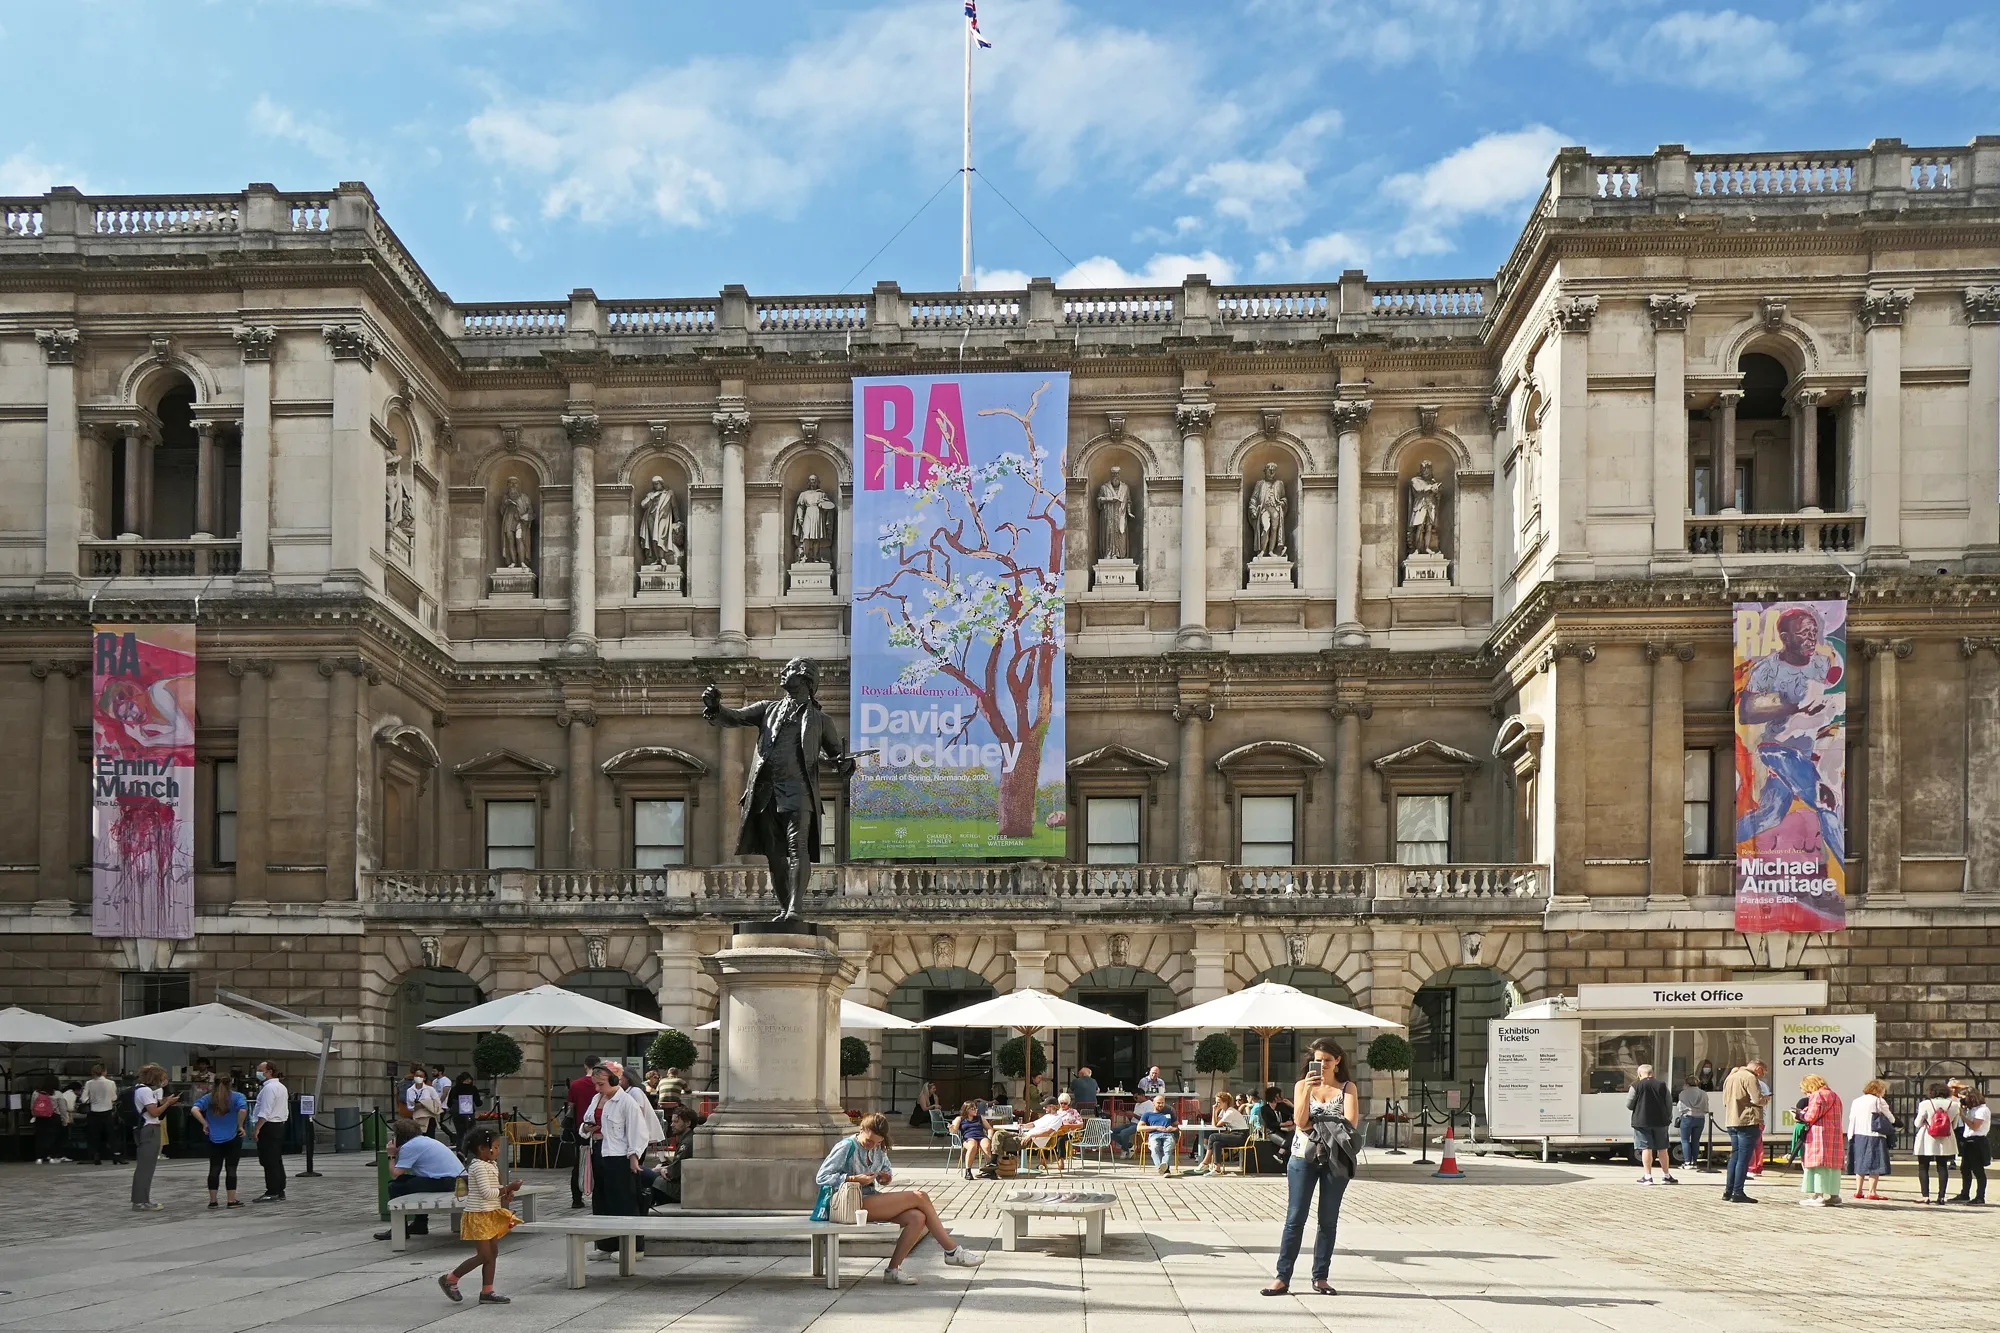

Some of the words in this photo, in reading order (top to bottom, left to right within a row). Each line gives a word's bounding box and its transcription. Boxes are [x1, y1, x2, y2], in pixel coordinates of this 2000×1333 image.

[864, 383, 973, 490] RA
[1737, 610, 1784, 657] RA
[97, 632, 140, 676] RA
[861, 685, 893, 697] Royal
[895, 686, 946, 697] Academy
[947, 686, 959, 696] of
[861, 703, 962, 735] David
[861, 737, 1023, 774] Hockney
[96, 754, 175, 776] Emin/
[96, 776, 180, 798] Munch
[1741, 857, 1819, 876] Michael
[1741, 876, 1837, 896] Armitage
[838, 897, 890, 909] ROYAL
[1740, 897, 1775, 905] Paradise
[1776, 896, 1798, 904] Edict
[1653, 990, 1697, 1002] Ticket
[1700, 989, 1744, 1001] Office
[1498, 1027, 1540, 1035] Exhibition
[1783, 1024, 1841, 1033] Welcome
[1498, 1034, 1530, 1042] Tickets
[1783, 1035, 1796, 1045] to
[1799, 1034, 1818, 1044] the
[1821, 1034, 1856, 1046] Royal
[1783, 1046, 1840, 1056] Academy
[1783, 1056, 1796, 1067] of
[1798, 1056, 1825, 1067] Arts
[1782, 1110, 1796, 1127] R
